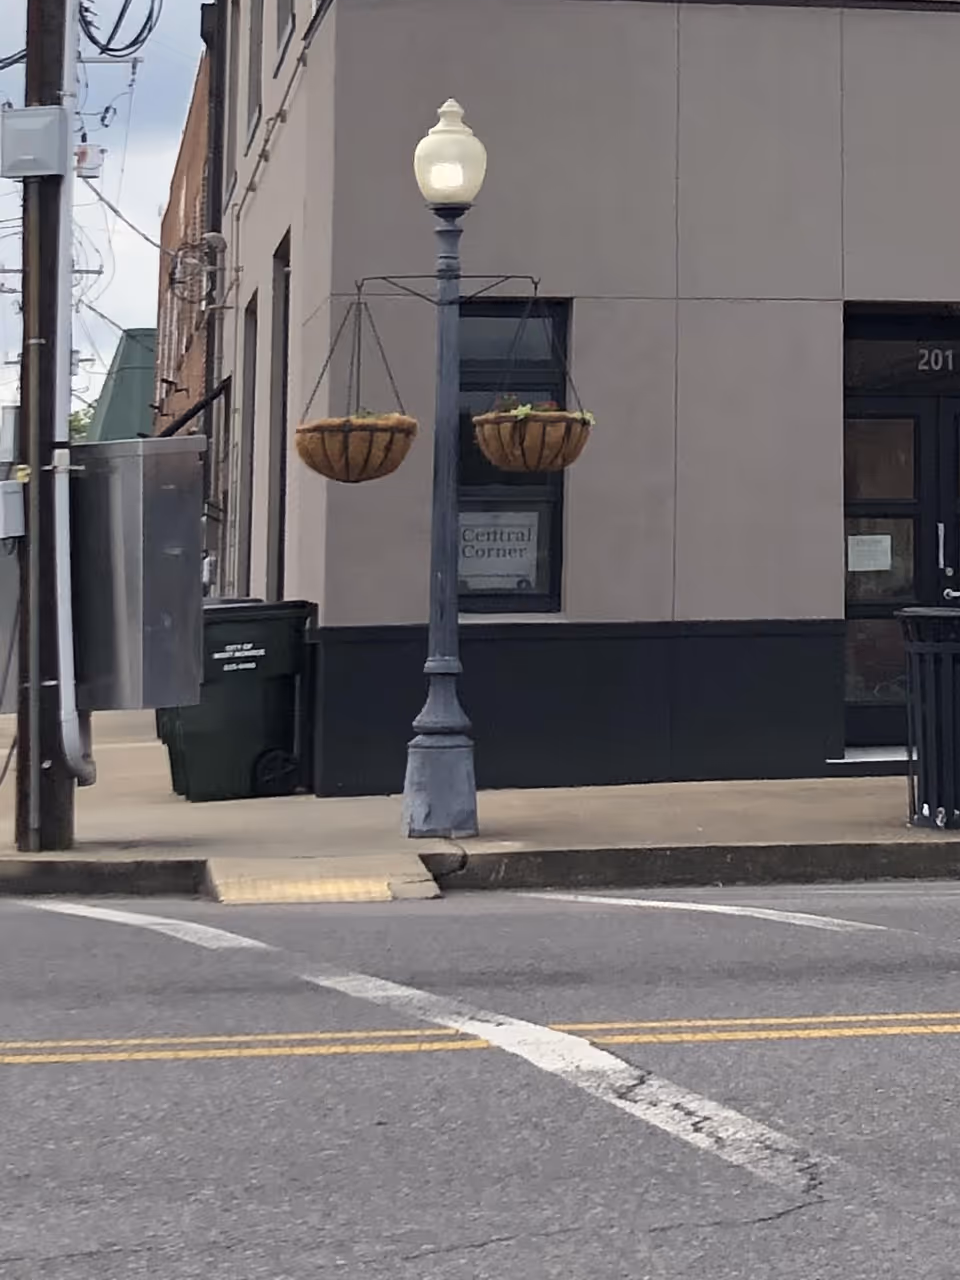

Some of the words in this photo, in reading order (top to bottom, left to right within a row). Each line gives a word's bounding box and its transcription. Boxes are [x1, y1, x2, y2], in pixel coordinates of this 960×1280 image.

[918, 348, 953, 371] 201
[462, 527, 531, 542] Central
[462, 544, 527, 558] Corner
